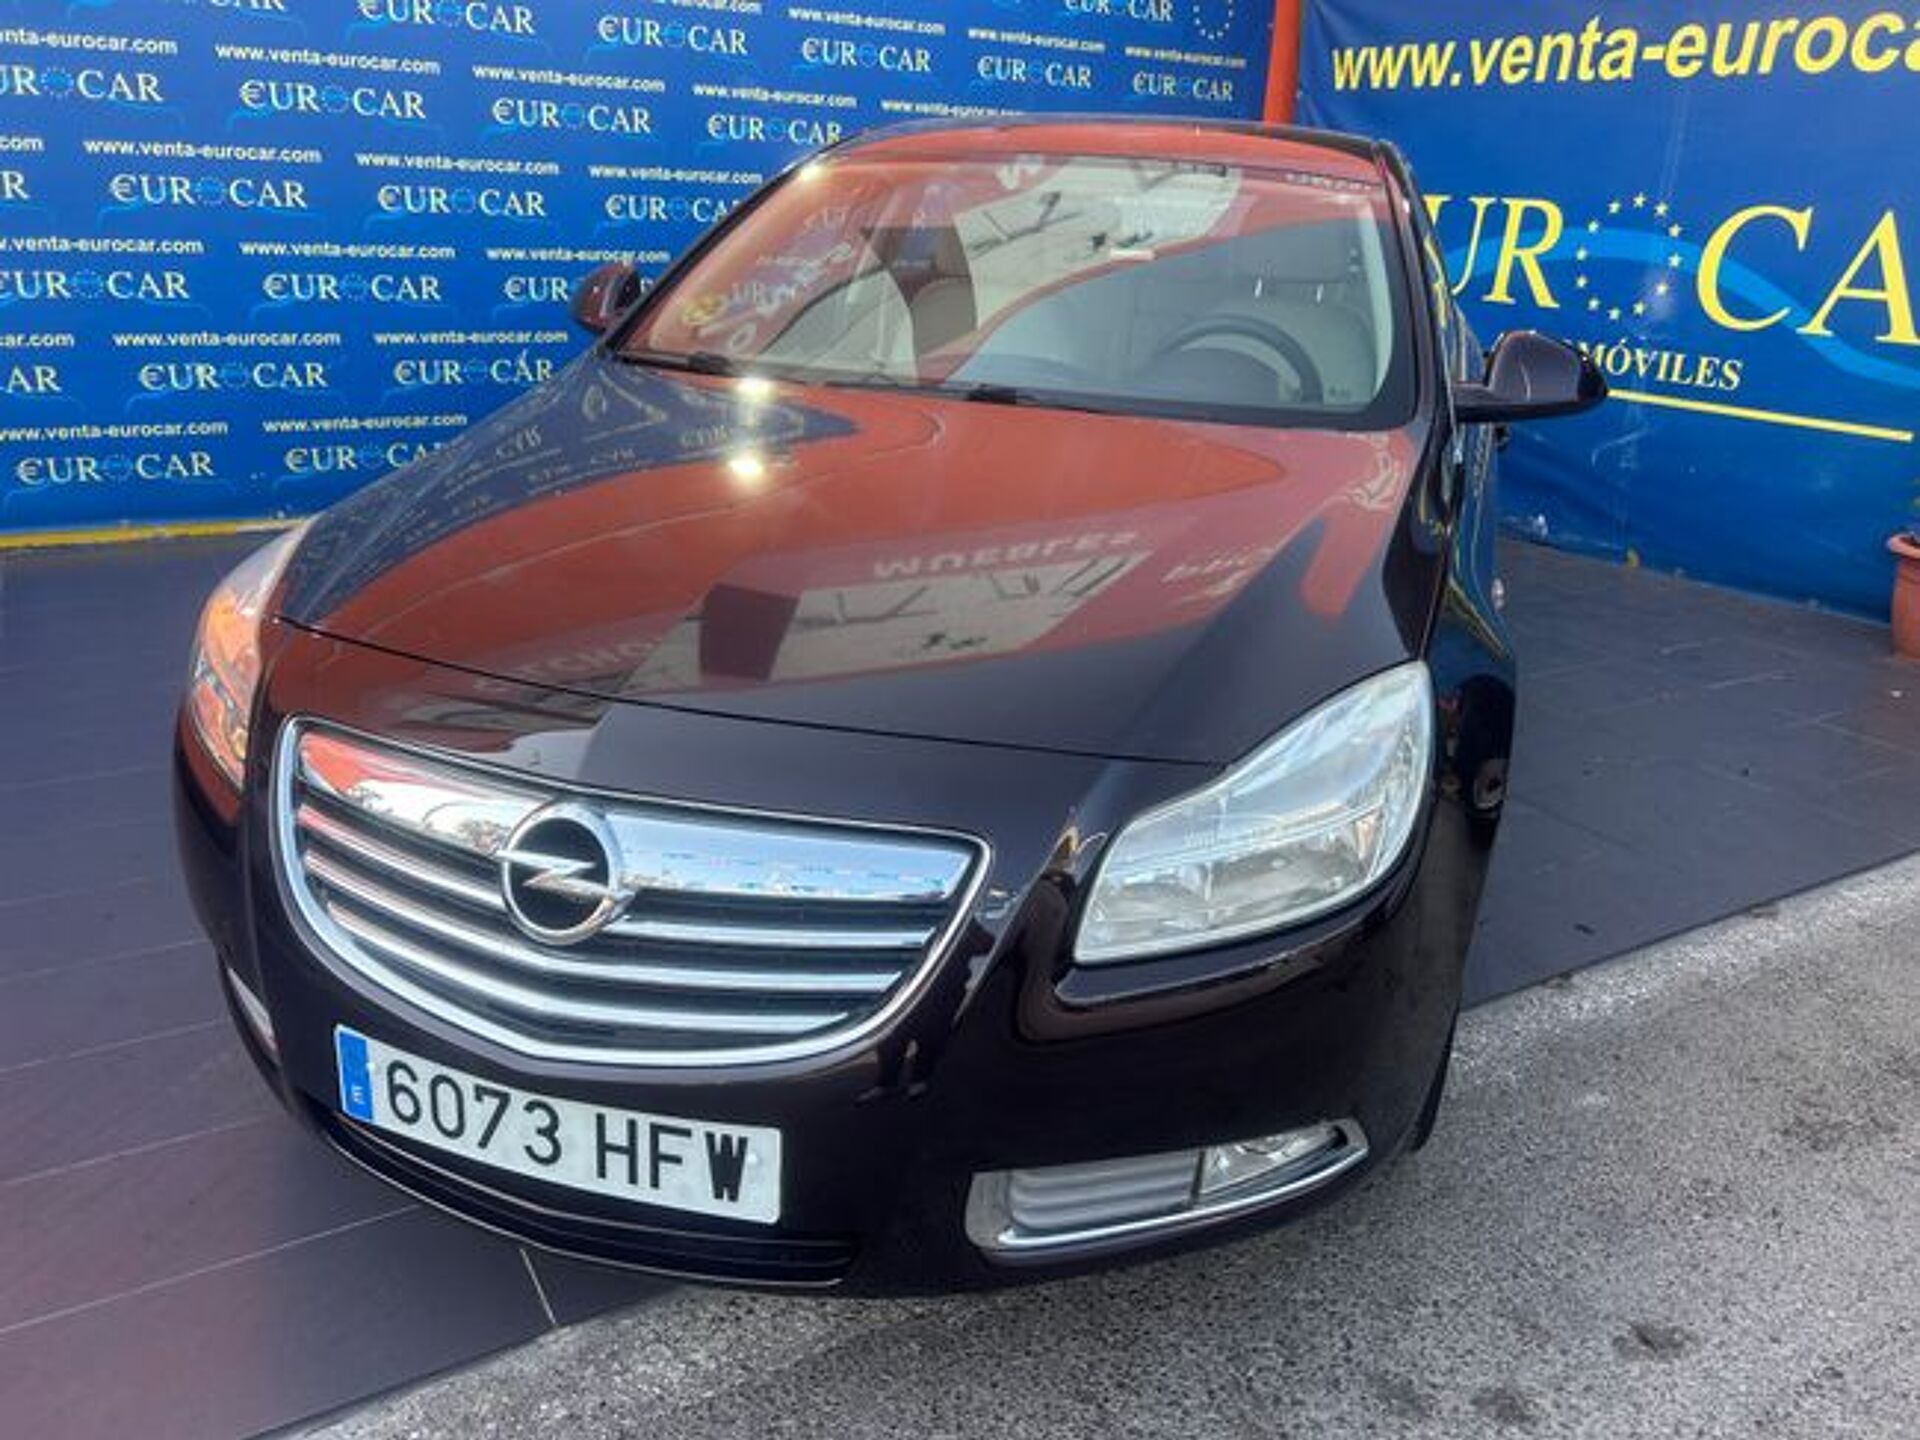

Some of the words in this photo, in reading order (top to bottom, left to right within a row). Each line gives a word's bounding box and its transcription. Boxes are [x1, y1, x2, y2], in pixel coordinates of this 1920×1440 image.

[215, 44, 440, 75] www.venta-eurocar.com
[472, 64, 665, 93] www.venta-eurocar.com
[83, 138, 322, 163] www.venta-eurocar.com
[354, 152, 560, 175] www.venta-eurocar.com
[239, 241, 456, 258] www.venta-eurocar.com
[112, 330, 341, 347] www.venta-eurocar.com
[374, 328, 568, 344] www.venta-eurocar.com
[262, 413, 468, 432] www.venta-eurocar.com
[386, 1060, 563, 1166] 6073
[595, 1112, 749, 1202] HFW
